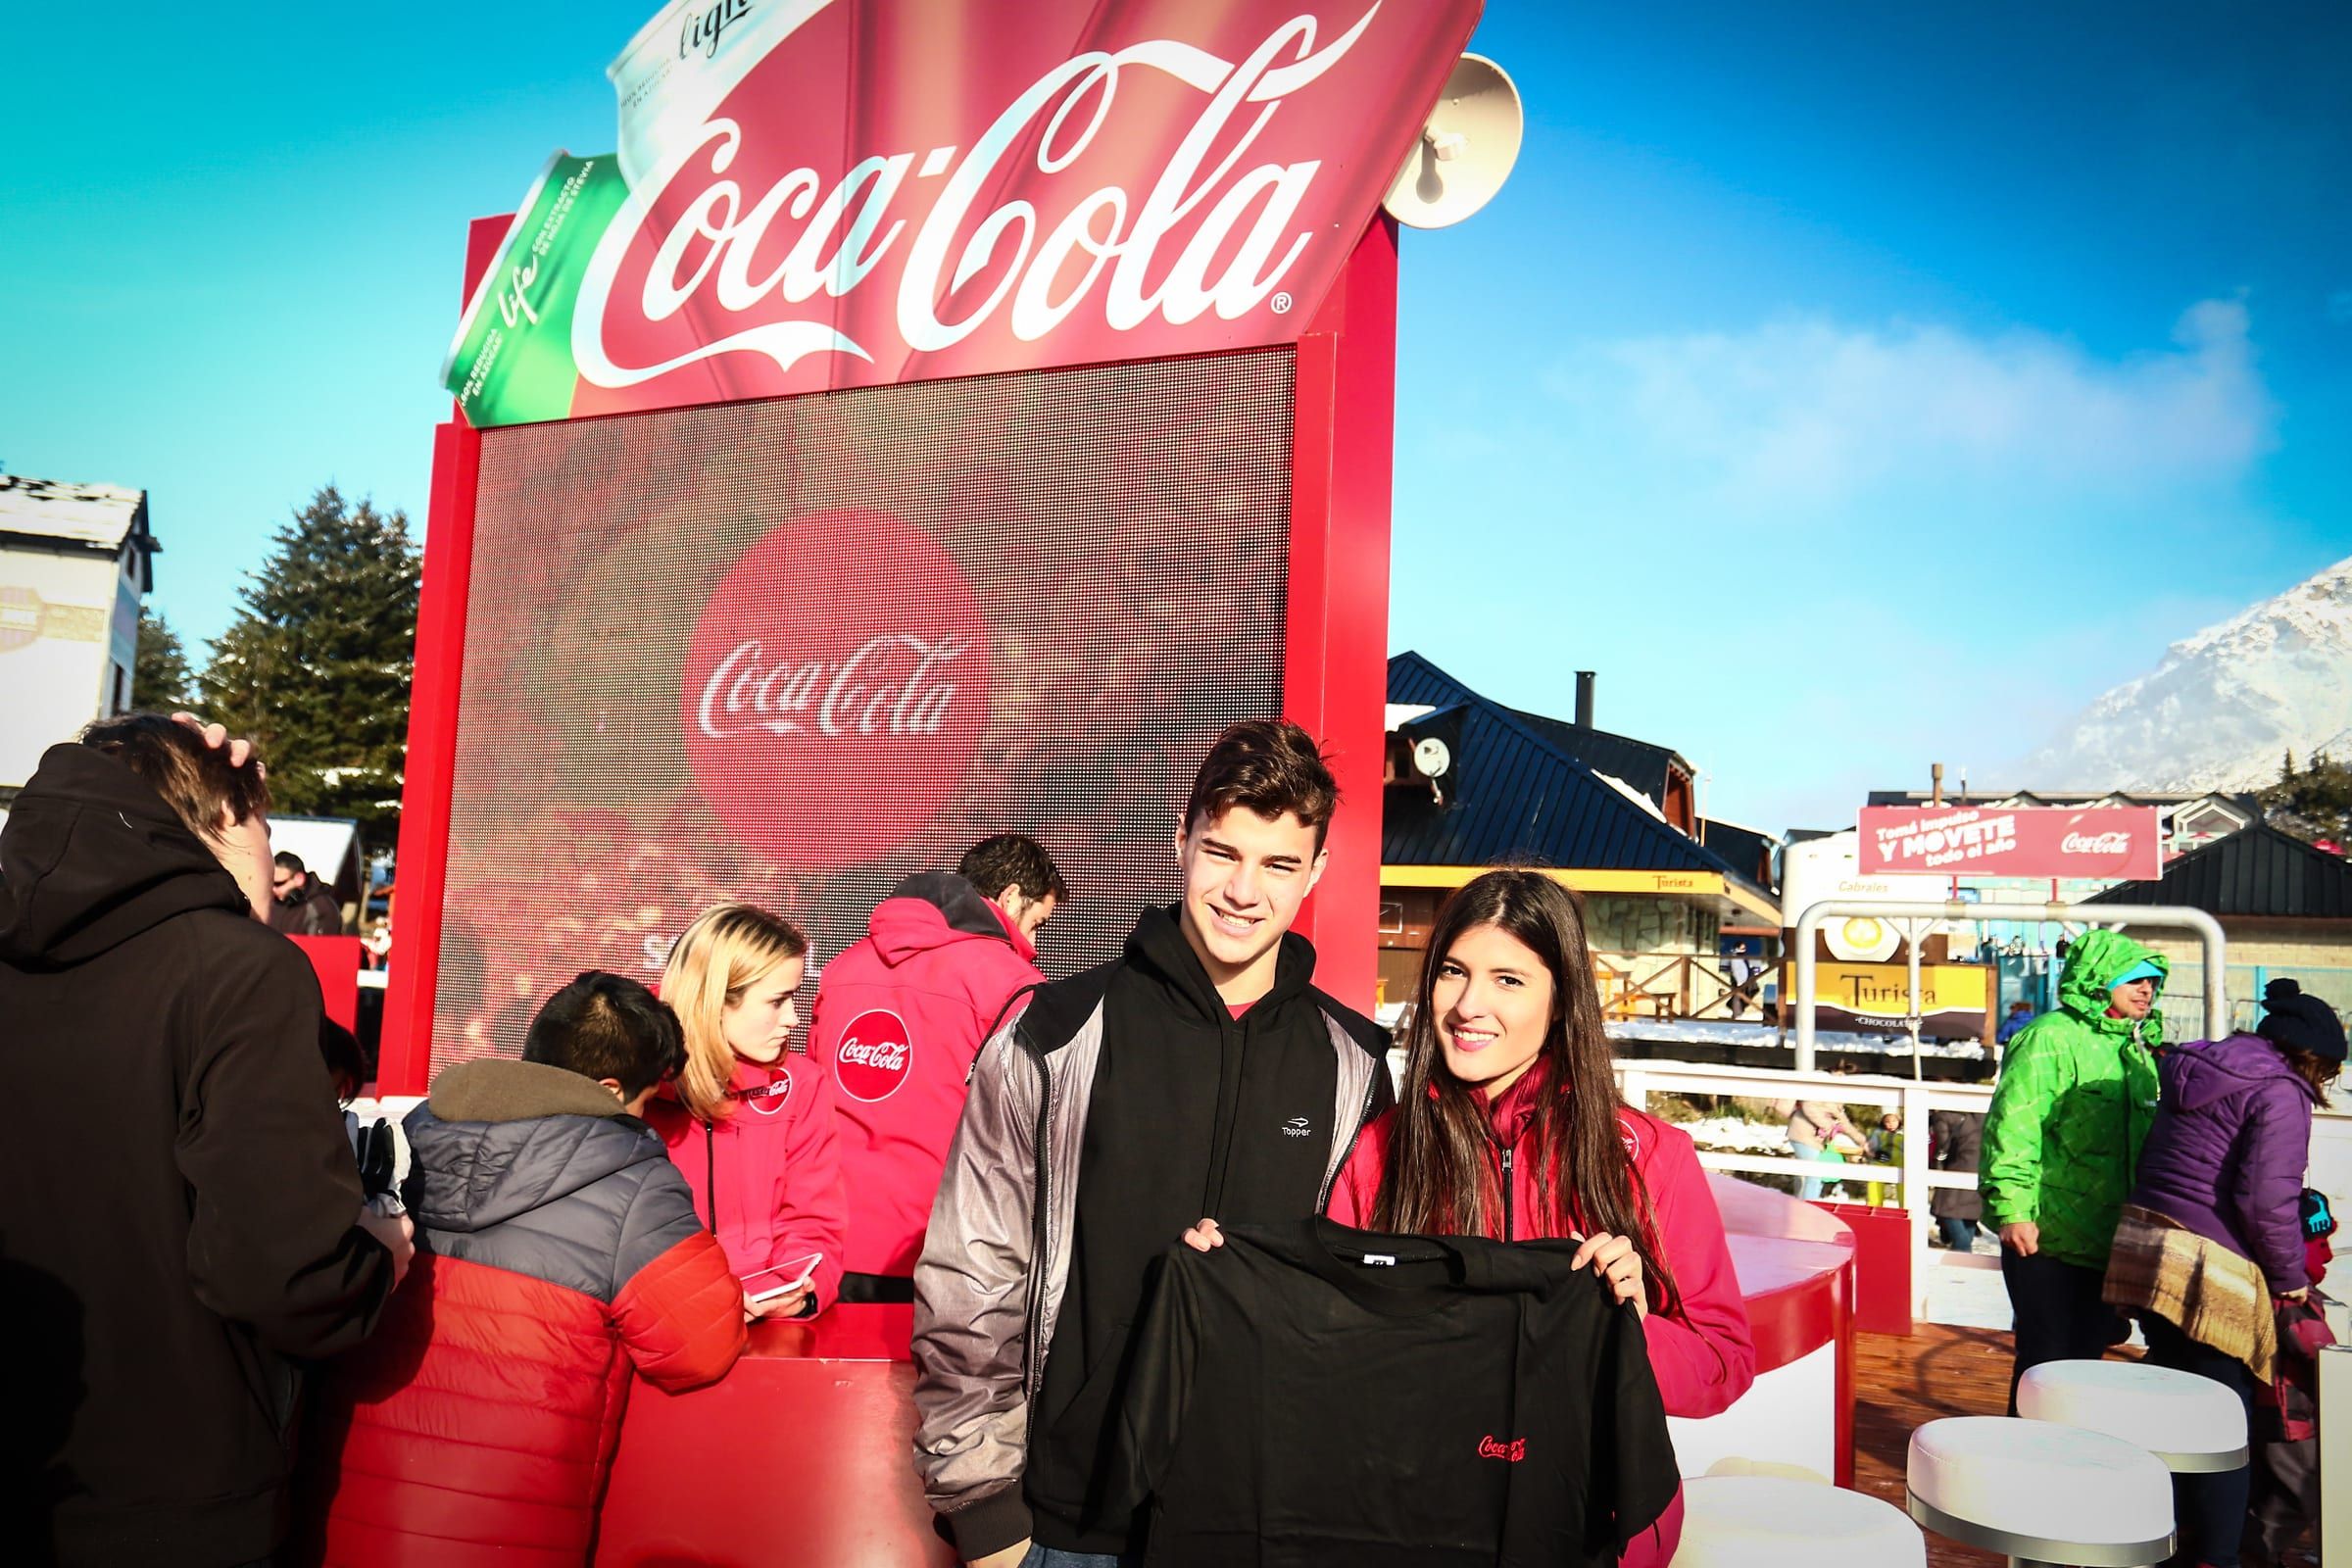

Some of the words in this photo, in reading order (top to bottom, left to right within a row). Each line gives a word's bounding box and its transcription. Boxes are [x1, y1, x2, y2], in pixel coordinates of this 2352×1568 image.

[570, 161, 595, 197] STEVIA
[571, 0, 1384, 388] Coca-Cola
[544, 176, 576, 231] EXTRACTO
[498, 255, 538, 328] life
[472, 380, 483, 397] EN
[698, 634, 962, 737] Coca-Cola
[1877, 840, 1897, 862] Y
[1902, 814, 2016, 858] MOVETE
[2061, 830, 2132, 854] Coca-Cola
[1926, 848, 1964, 867] todo
[1967, 843, 1982, 859] el
[1652, 875, 1693, 890] Turista
[1838, 880, 1888, 893] Cabrales
[1840, 974, 1937, 1007] Turisa
[839, 1037, 908, 1071] Coca-Cola
[1282, 1126, 1311, 1138] Topper
